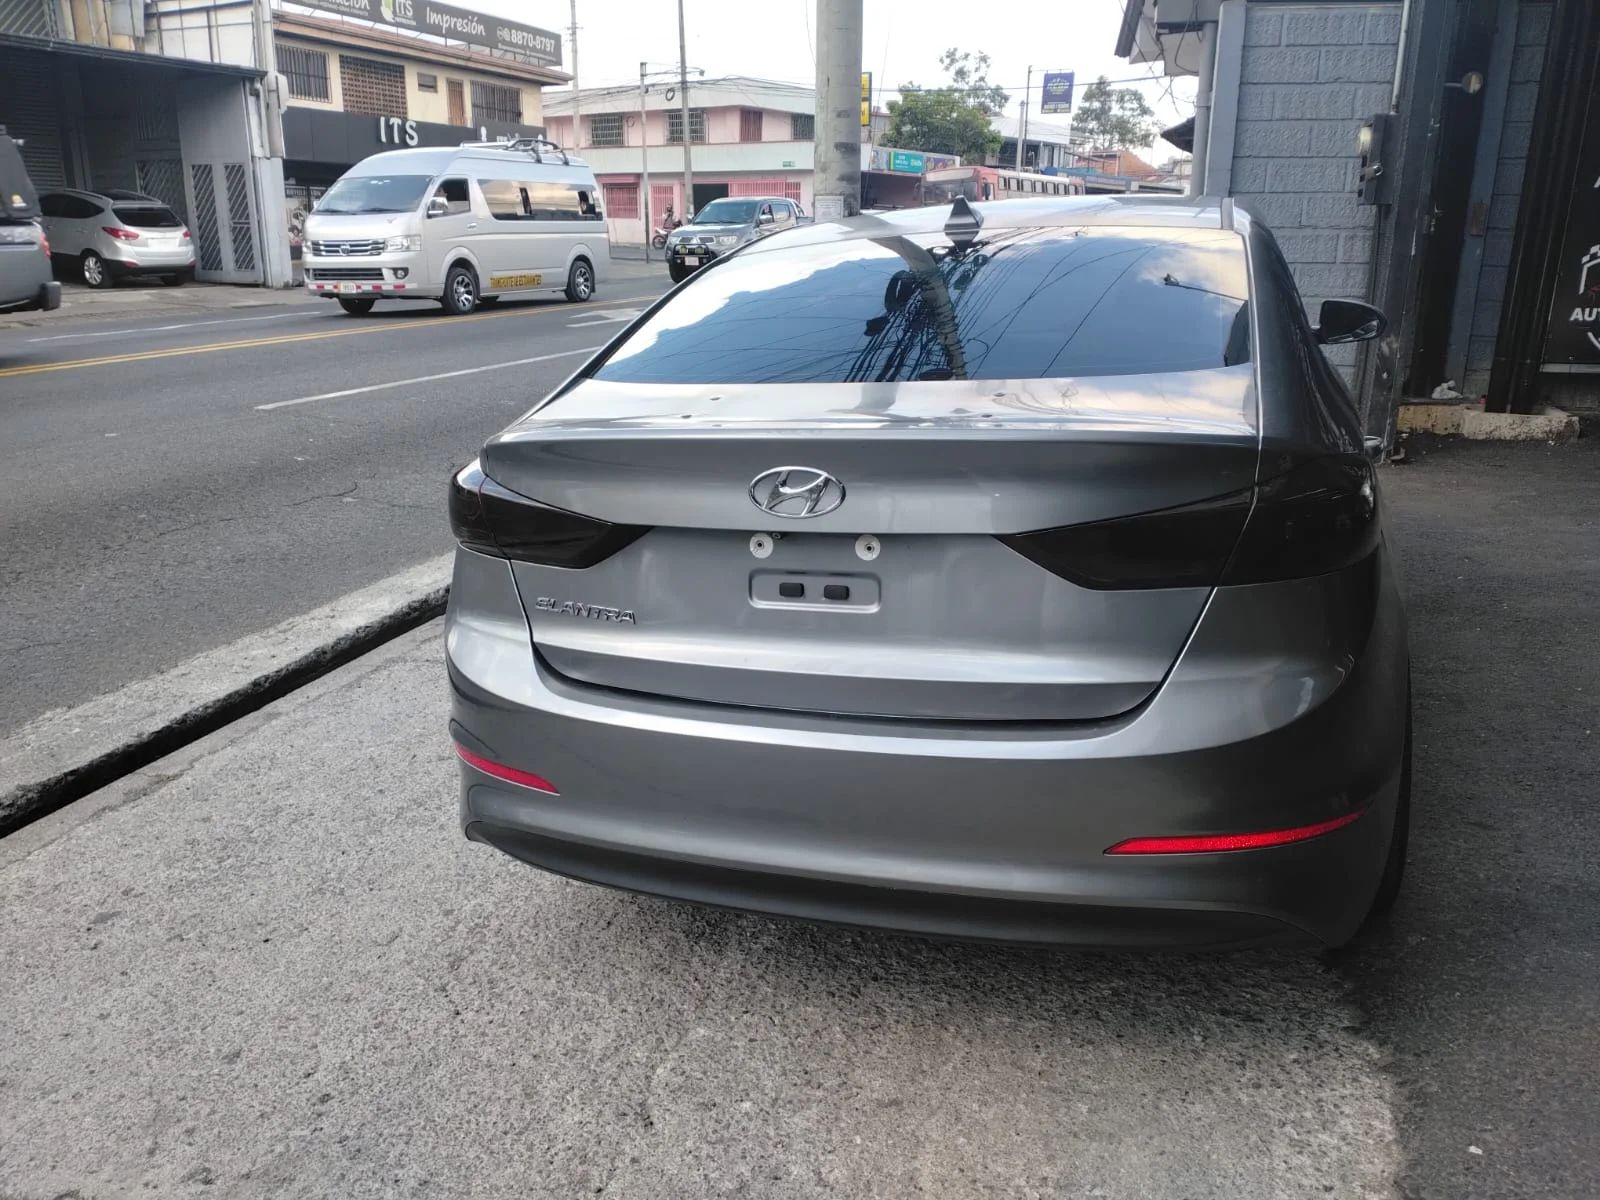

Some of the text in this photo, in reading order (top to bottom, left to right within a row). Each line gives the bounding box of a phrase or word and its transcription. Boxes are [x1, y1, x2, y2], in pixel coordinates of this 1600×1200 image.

[425, 6, 486, 36] Impresión
[511, 29, 555, 54] 8870-8797
[380, 116, 419, 146] ITS
[535, 597, 636, 624] ELANTRA
